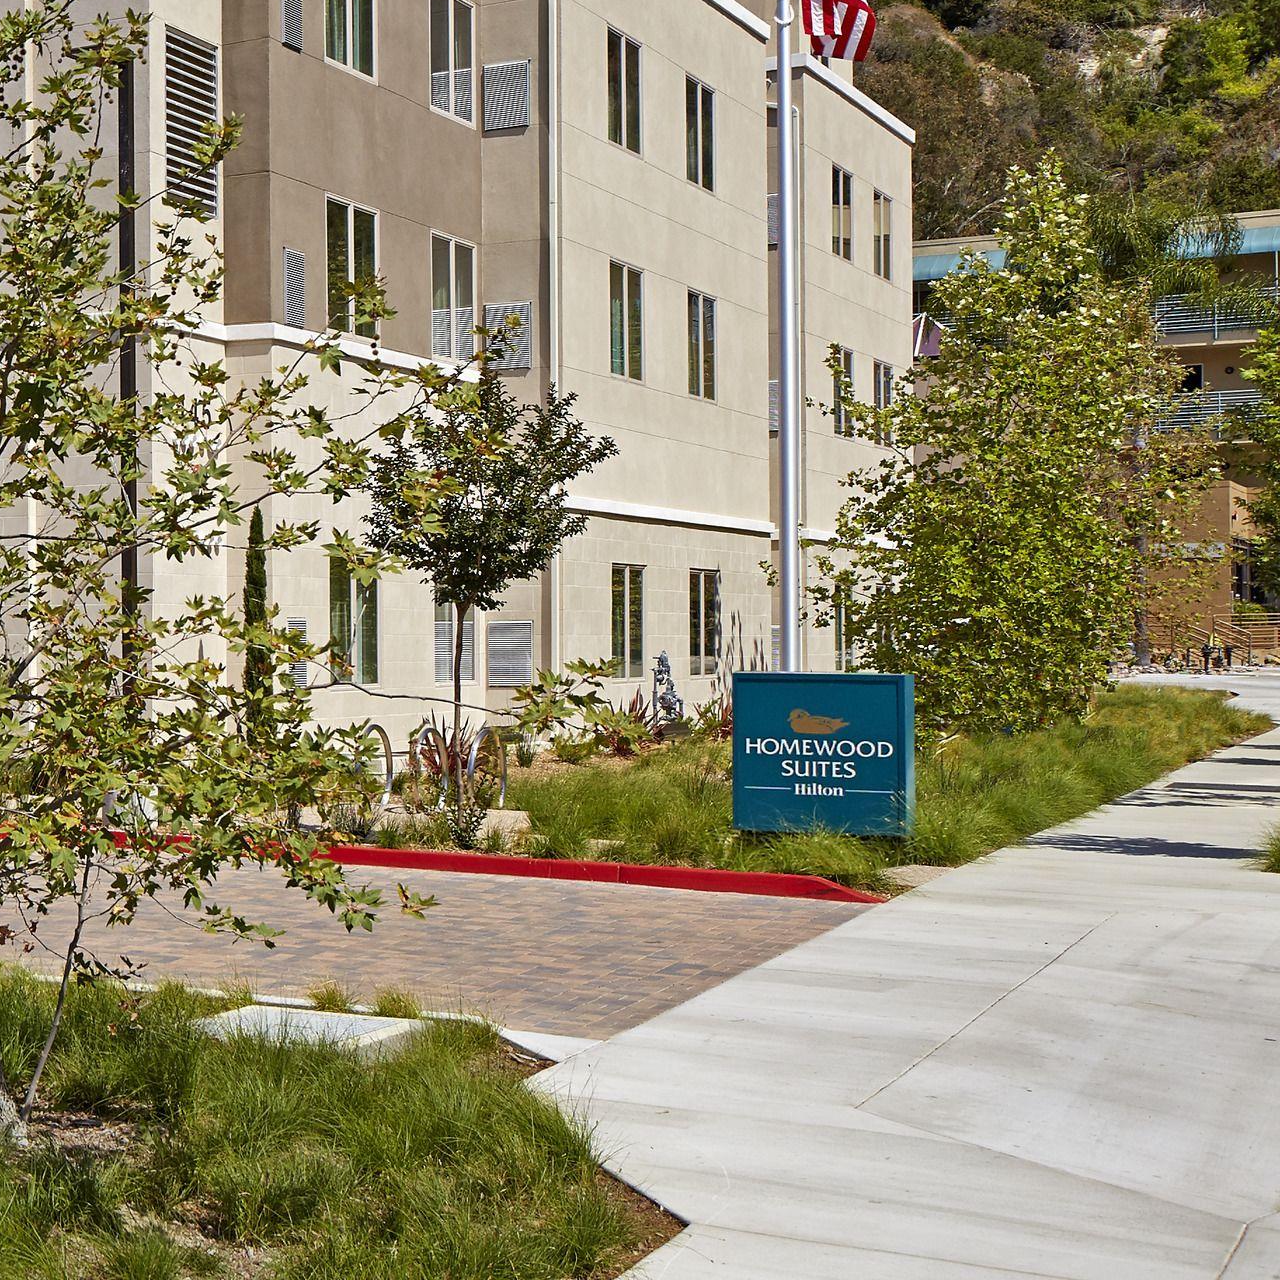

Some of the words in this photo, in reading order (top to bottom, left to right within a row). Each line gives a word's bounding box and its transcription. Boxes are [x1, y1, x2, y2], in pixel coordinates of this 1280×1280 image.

[745, 737, 894, 758] HOMEWOOD
[781, 760, 856, 778] SUITES
[794, 783, 844, 796] Hilton
